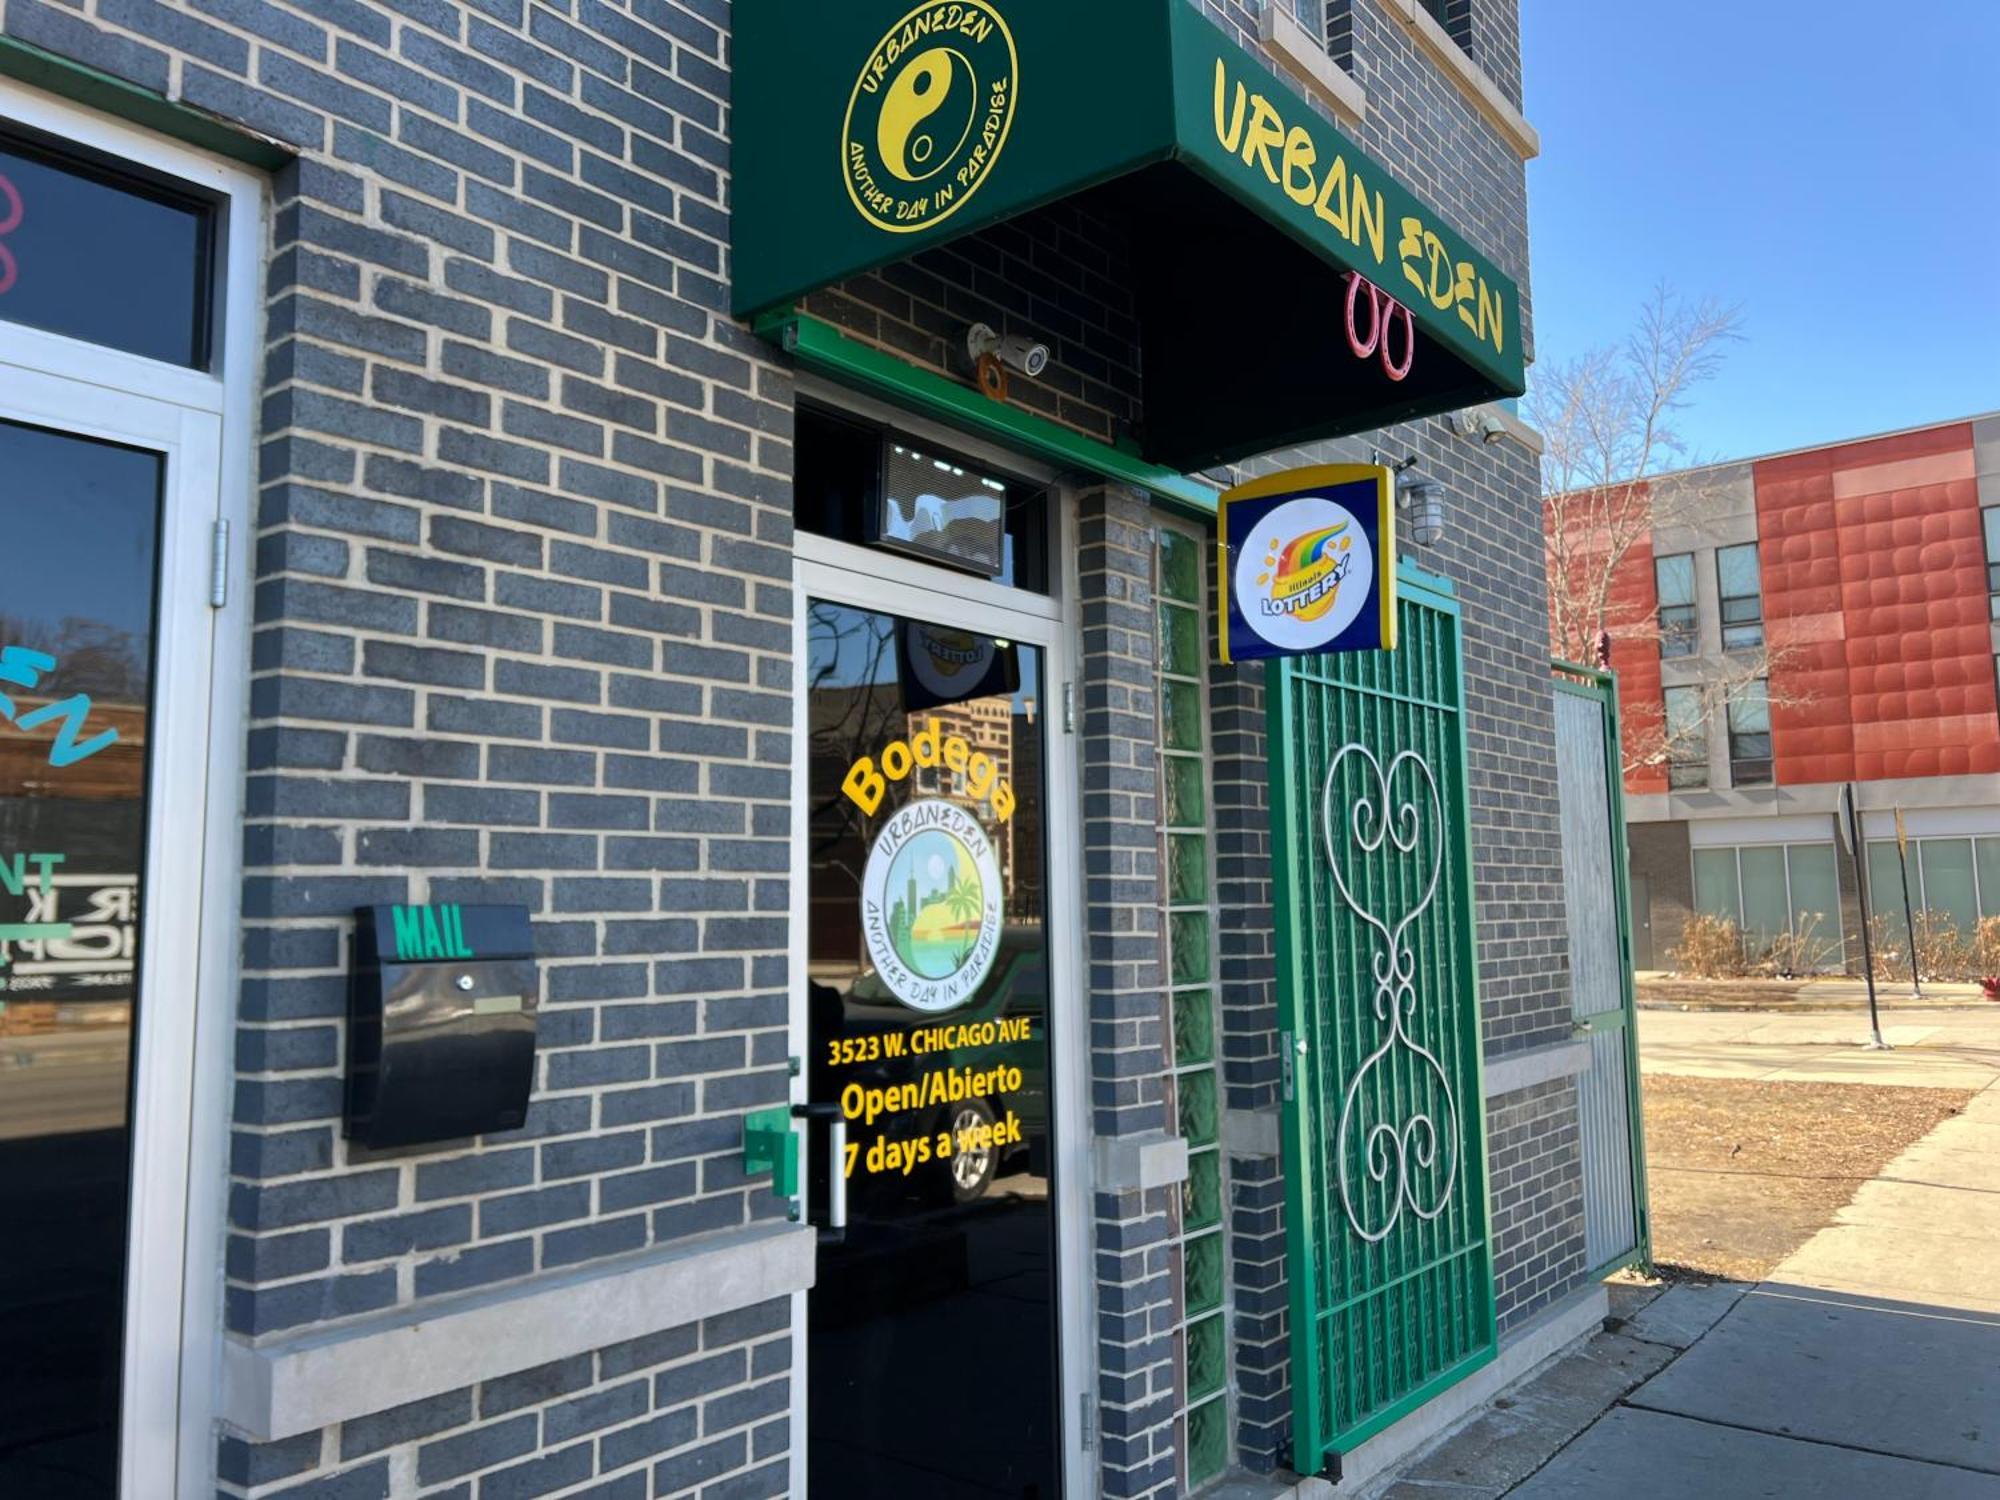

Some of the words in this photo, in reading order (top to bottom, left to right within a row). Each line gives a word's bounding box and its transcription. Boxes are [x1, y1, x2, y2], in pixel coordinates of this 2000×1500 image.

[862, 5, 993, 93] URBANEDEN
[850, 142, 894, 213] ANOTHER
[896, 198, 928, 220] DAY
[935, 184, 953, 209] IN
[957, 77, 1007, 186] PARADISE
[1214, 57, 1385, 264] URBAN
[1398, 217, 1503, 354] EDEN
[1261, 553, 1350, 616] LOTTERY
[841, 717, 1015, 822] Bodega
[878, 803, 987, 857] URBANEDEN
[392, 904, 473, 958] MAIL
[866, 900, 907, 986] ANOTHER
[911, 983, 937, 1003] DAY
[943, 983, 958, 1001] IN
[828, 1036, 879, 1065] 3523
[884, 1032, 907, 1058] W.
[911, 1022, 994, 1054] CHICAGO
[998, 1018, 1030, 1042] AVE
[841, 1064, 1022, 1125] Open/Abierto
[845, 1143, 859, 1178] 7
[866, 1135, 930, 1176] days
[937, 1132, 951, 1158] a
[957, 1110, 1021, 1152] week
